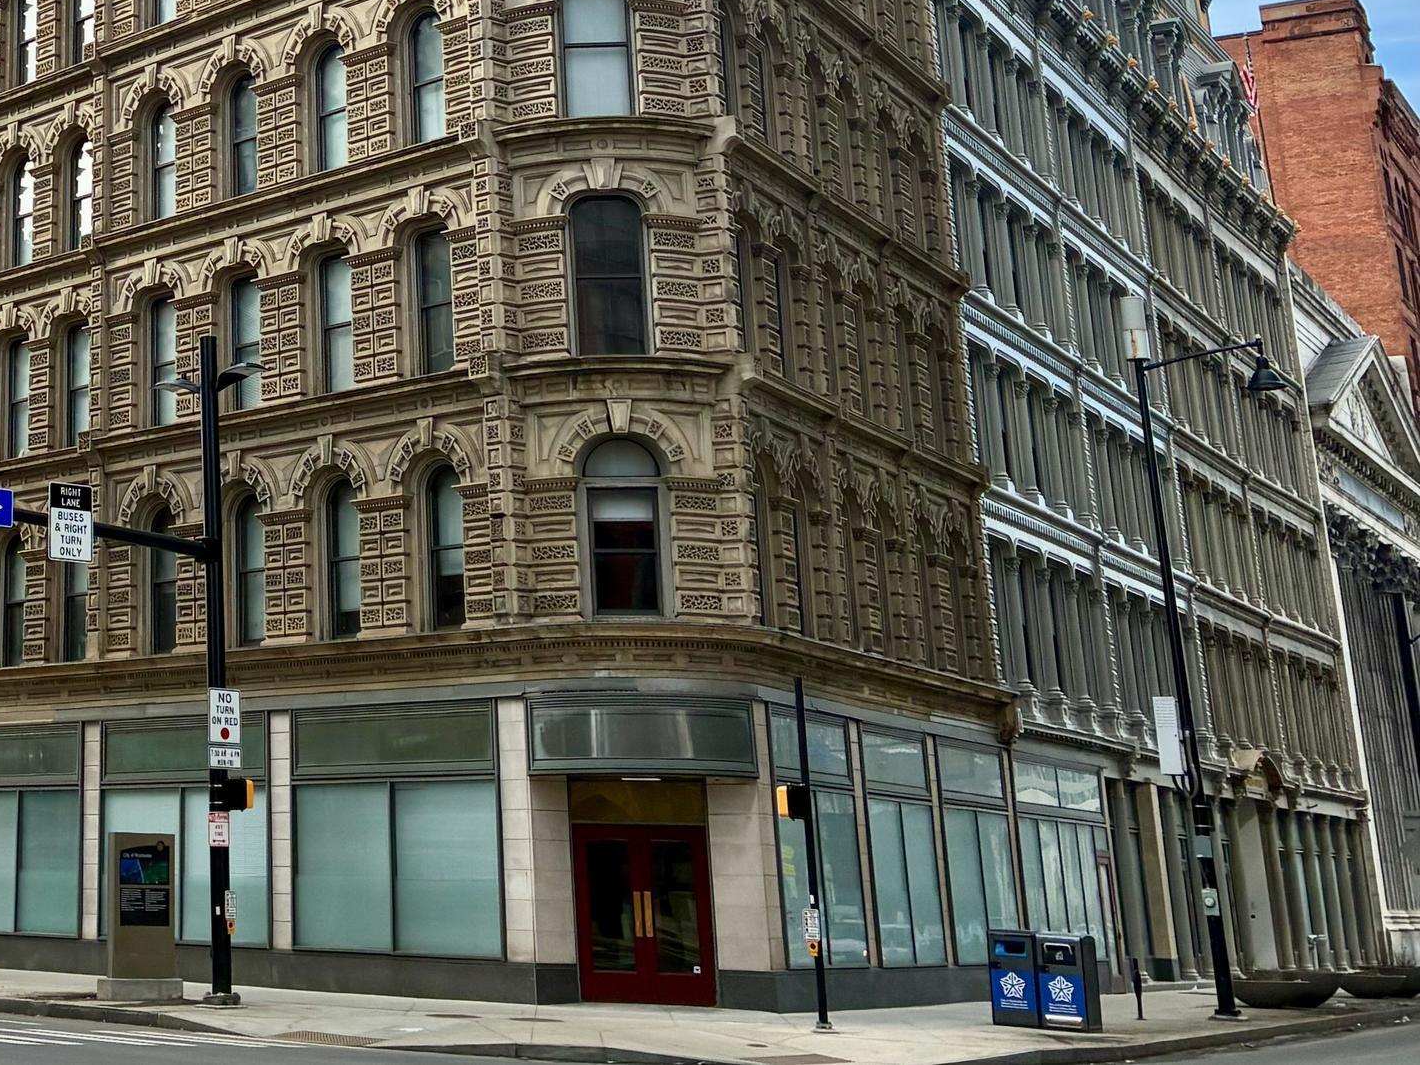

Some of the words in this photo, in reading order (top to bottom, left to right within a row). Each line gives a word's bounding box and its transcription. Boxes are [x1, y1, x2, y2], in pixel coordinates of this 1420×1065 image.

[60, 487, 81, 497] RIGHT
[61, 497, 81, 508] LANE
[57, 511, 85, 523] BUSES
[55, 522, 61, 532] &
[65, 523, 87, 535] RIGHT
[61, 535, 82, 546] TURN
[60, 547, 82, 558] ONLY
[218, 692, 232, 704] NO
[216, 705, 235, 715] TURN
[212, 716, 222, 725] ON
[225, 717, 238, 726] RED
